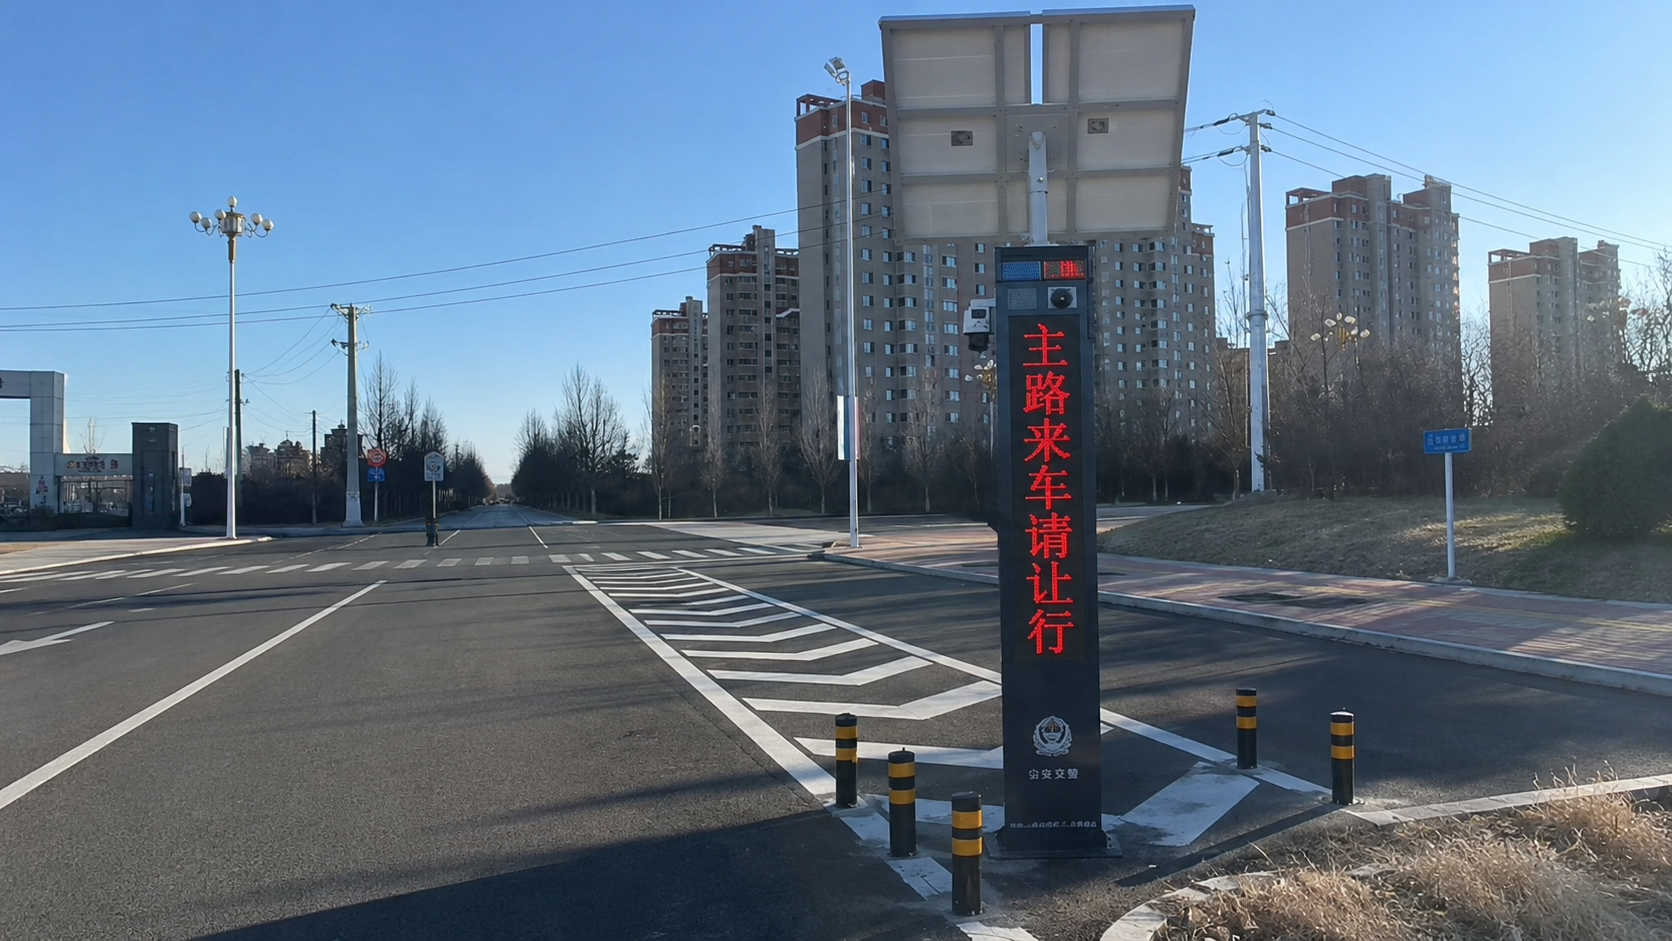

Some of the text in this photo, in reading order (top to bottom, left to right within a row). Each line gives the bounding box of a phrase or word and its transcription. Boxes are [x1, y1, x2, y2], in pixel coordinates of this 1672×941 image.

[1023, 323, 1074, 654] 主路来车请让行
